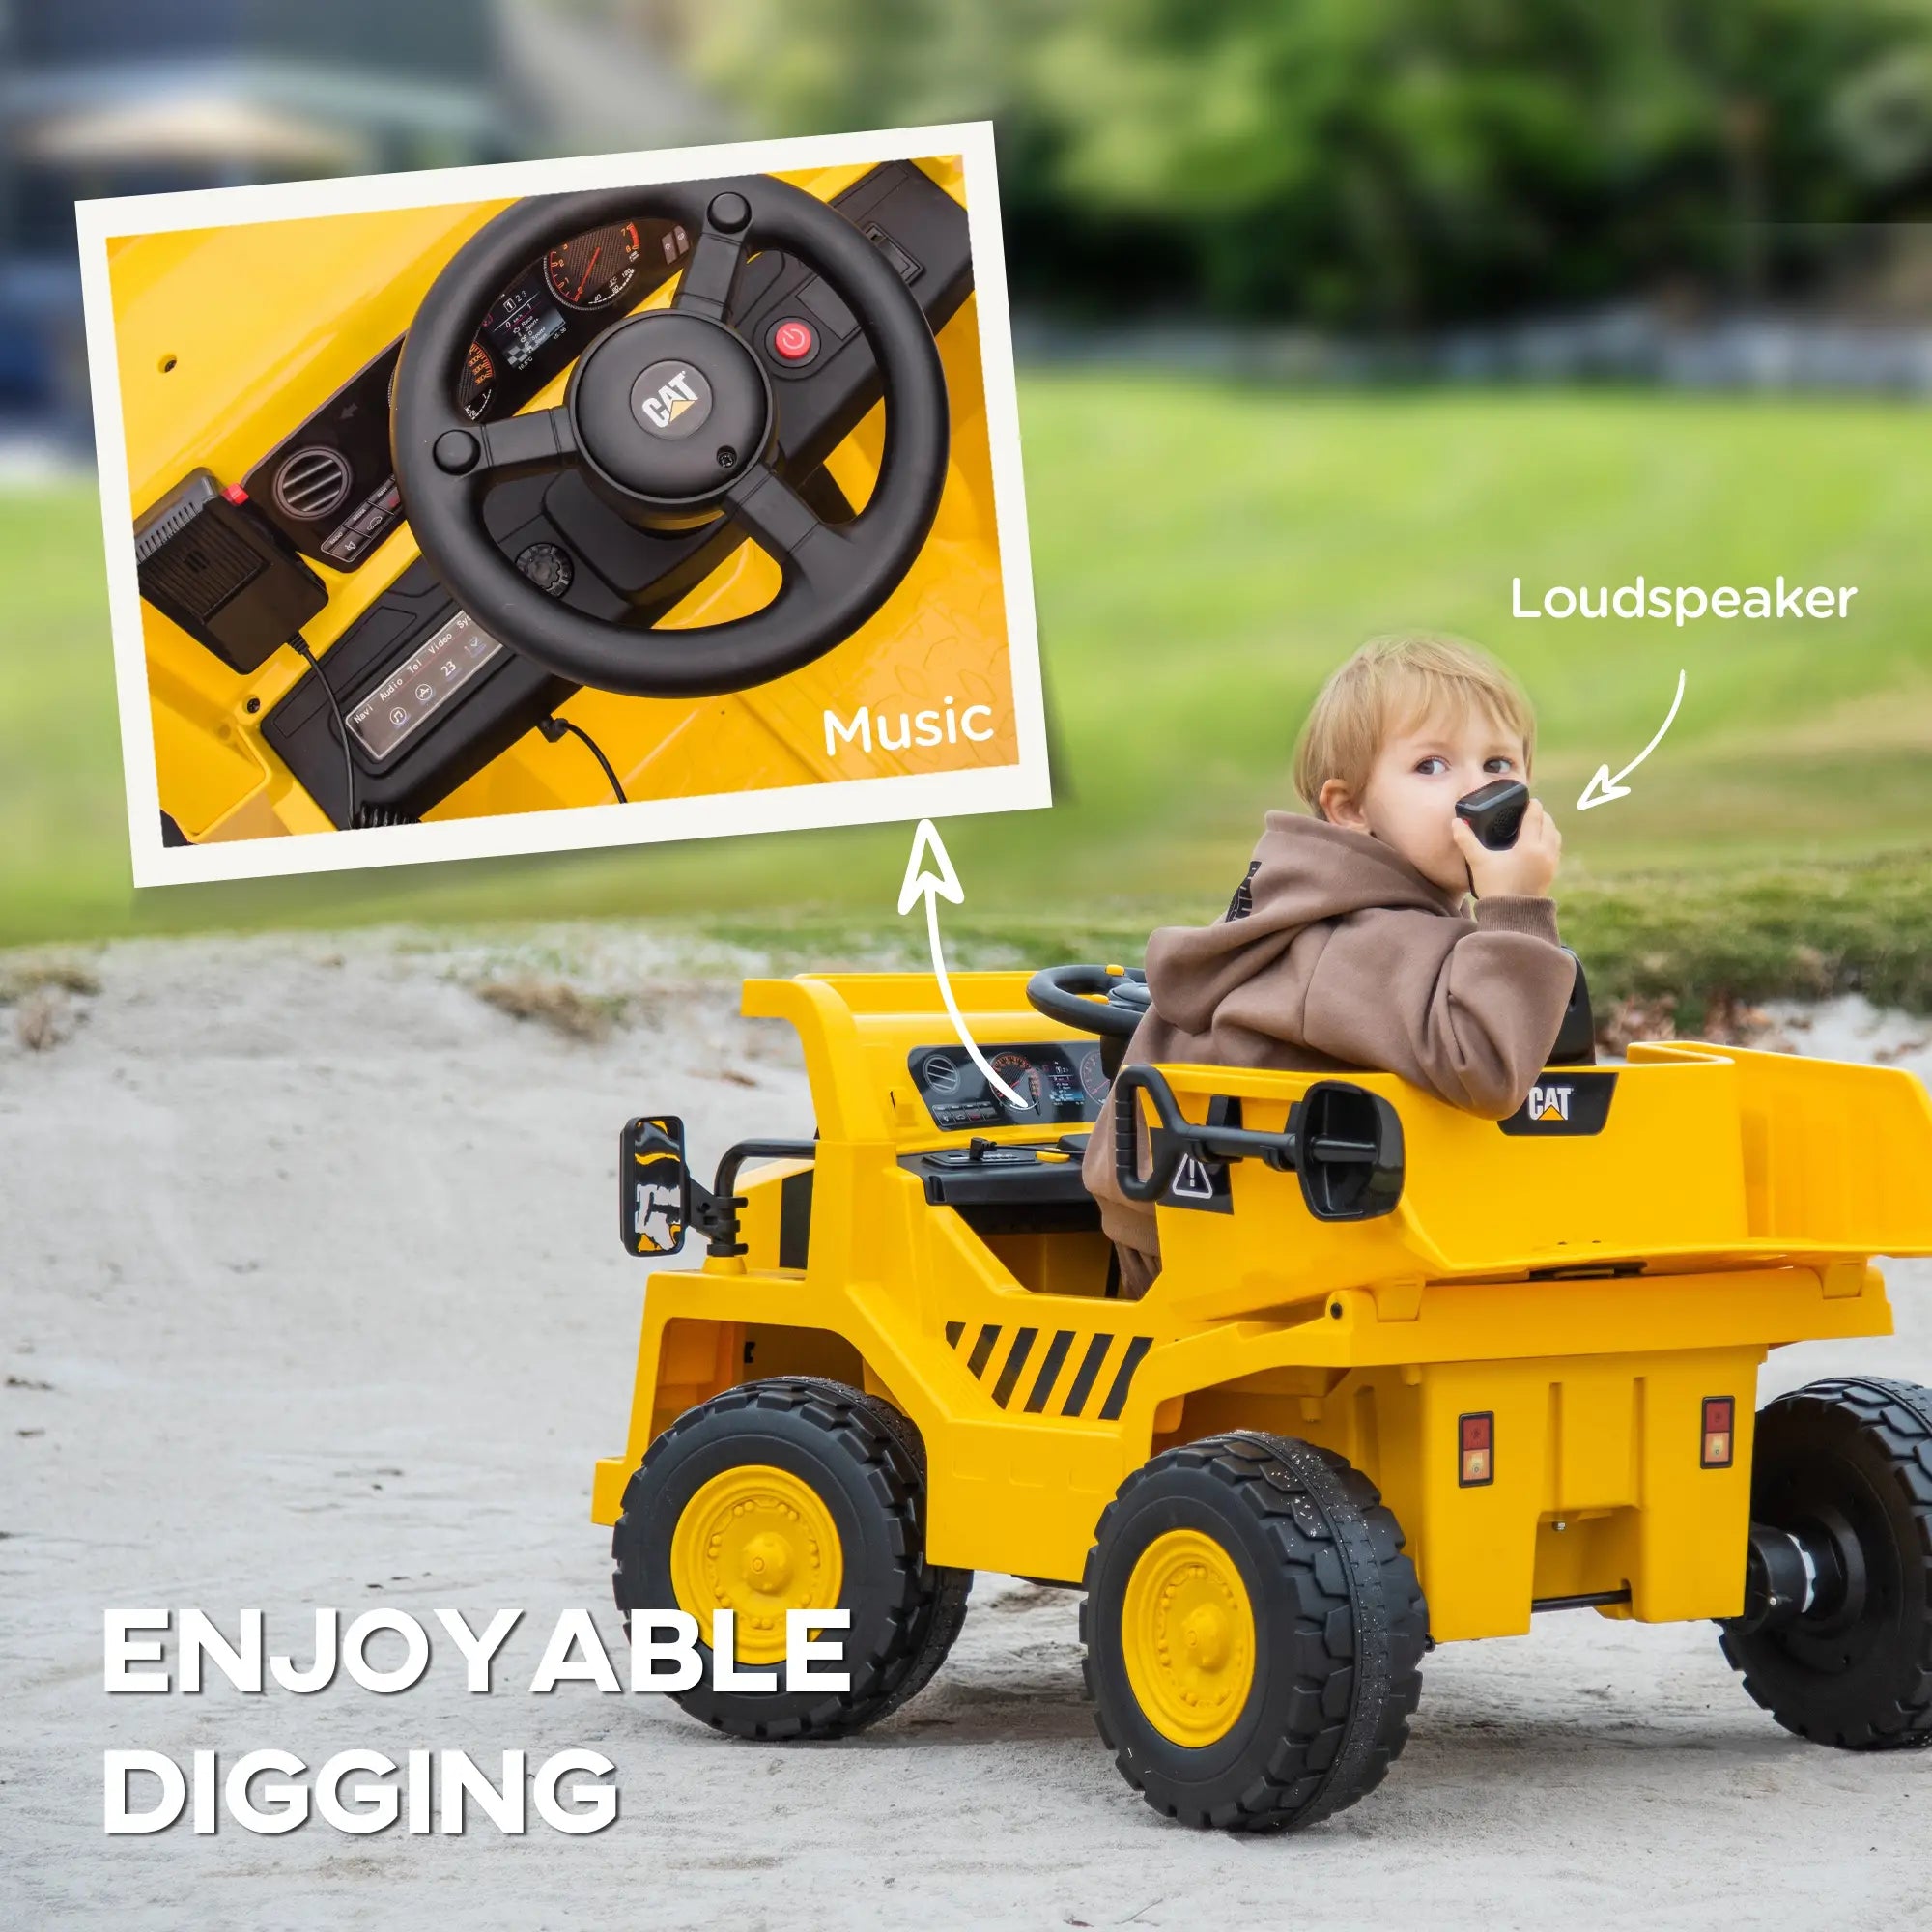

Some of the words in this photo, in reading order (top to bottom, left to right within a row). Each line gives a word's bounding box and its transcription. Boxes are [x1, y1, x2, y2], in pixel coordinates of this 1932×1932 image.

[641, 370, 699, 429] CAT
[353, 703, 373, 724] Navi
[379, 677, 404, 701] Audio
[407, 659, 423, 675] Tel
[428, 633, 453, 656] Video
[440, 661, 457, 678] 23
[1528, 1086, 1573, 1121] CAT
